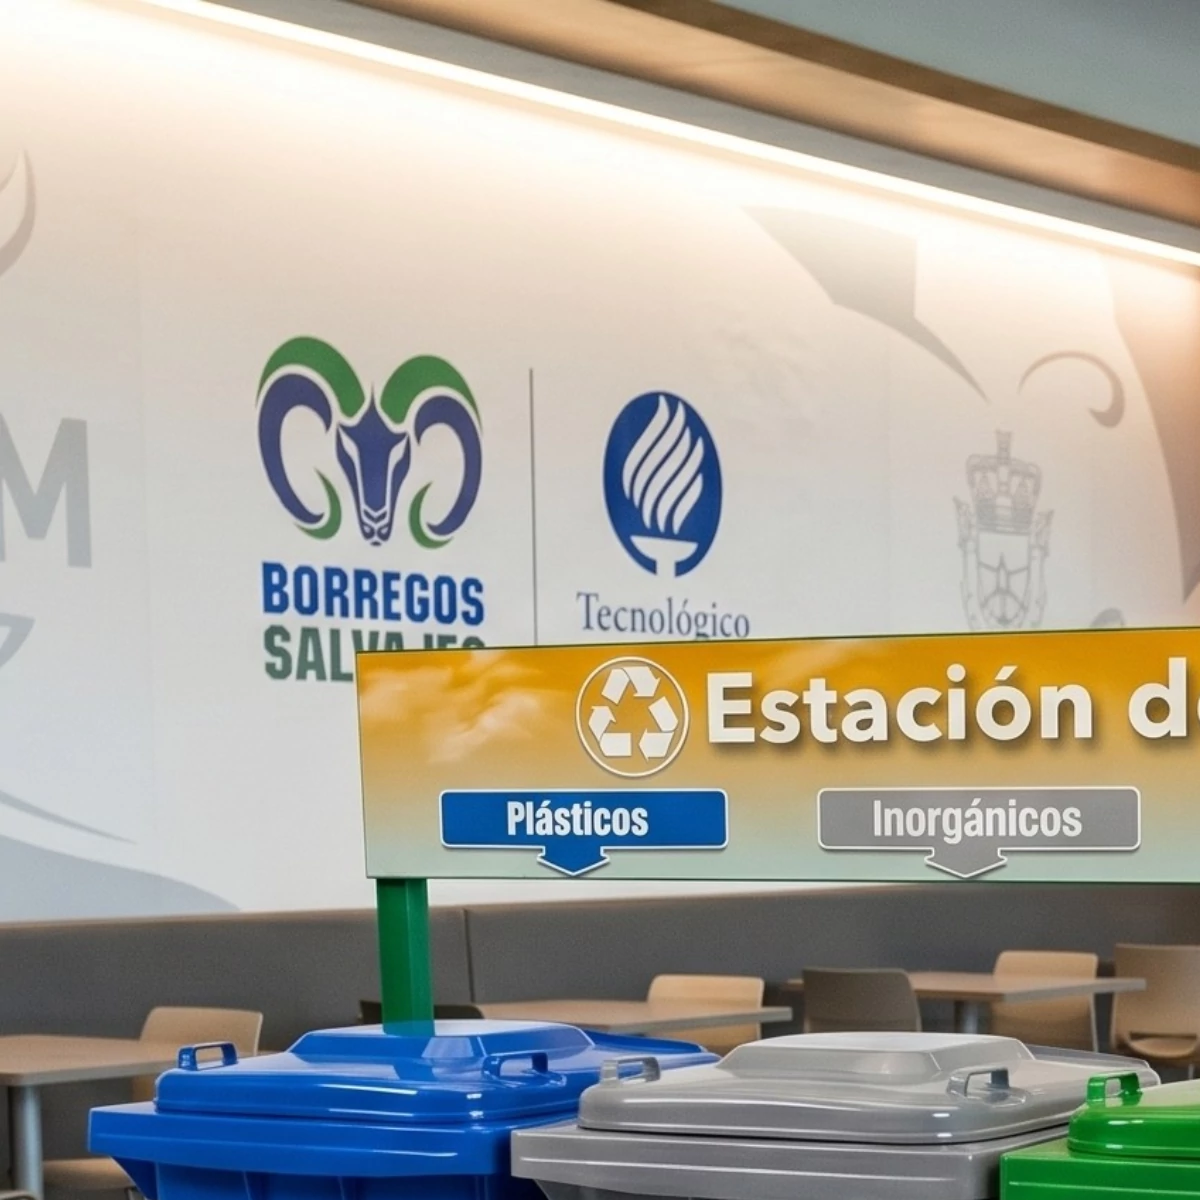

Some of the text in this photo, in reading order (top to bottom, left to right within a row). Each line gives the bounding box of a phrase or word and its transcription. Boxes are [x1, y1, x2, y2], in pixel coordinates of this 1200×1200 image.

[262, 562, 485, 627] BORREGOS
[576, 592, 750, 640] Tecnológico
[707, 663, 1093, 743] Estación
[507, 800, 649, 836] Plásticos
[873, 798, 1082, 844] Inorgánicos
